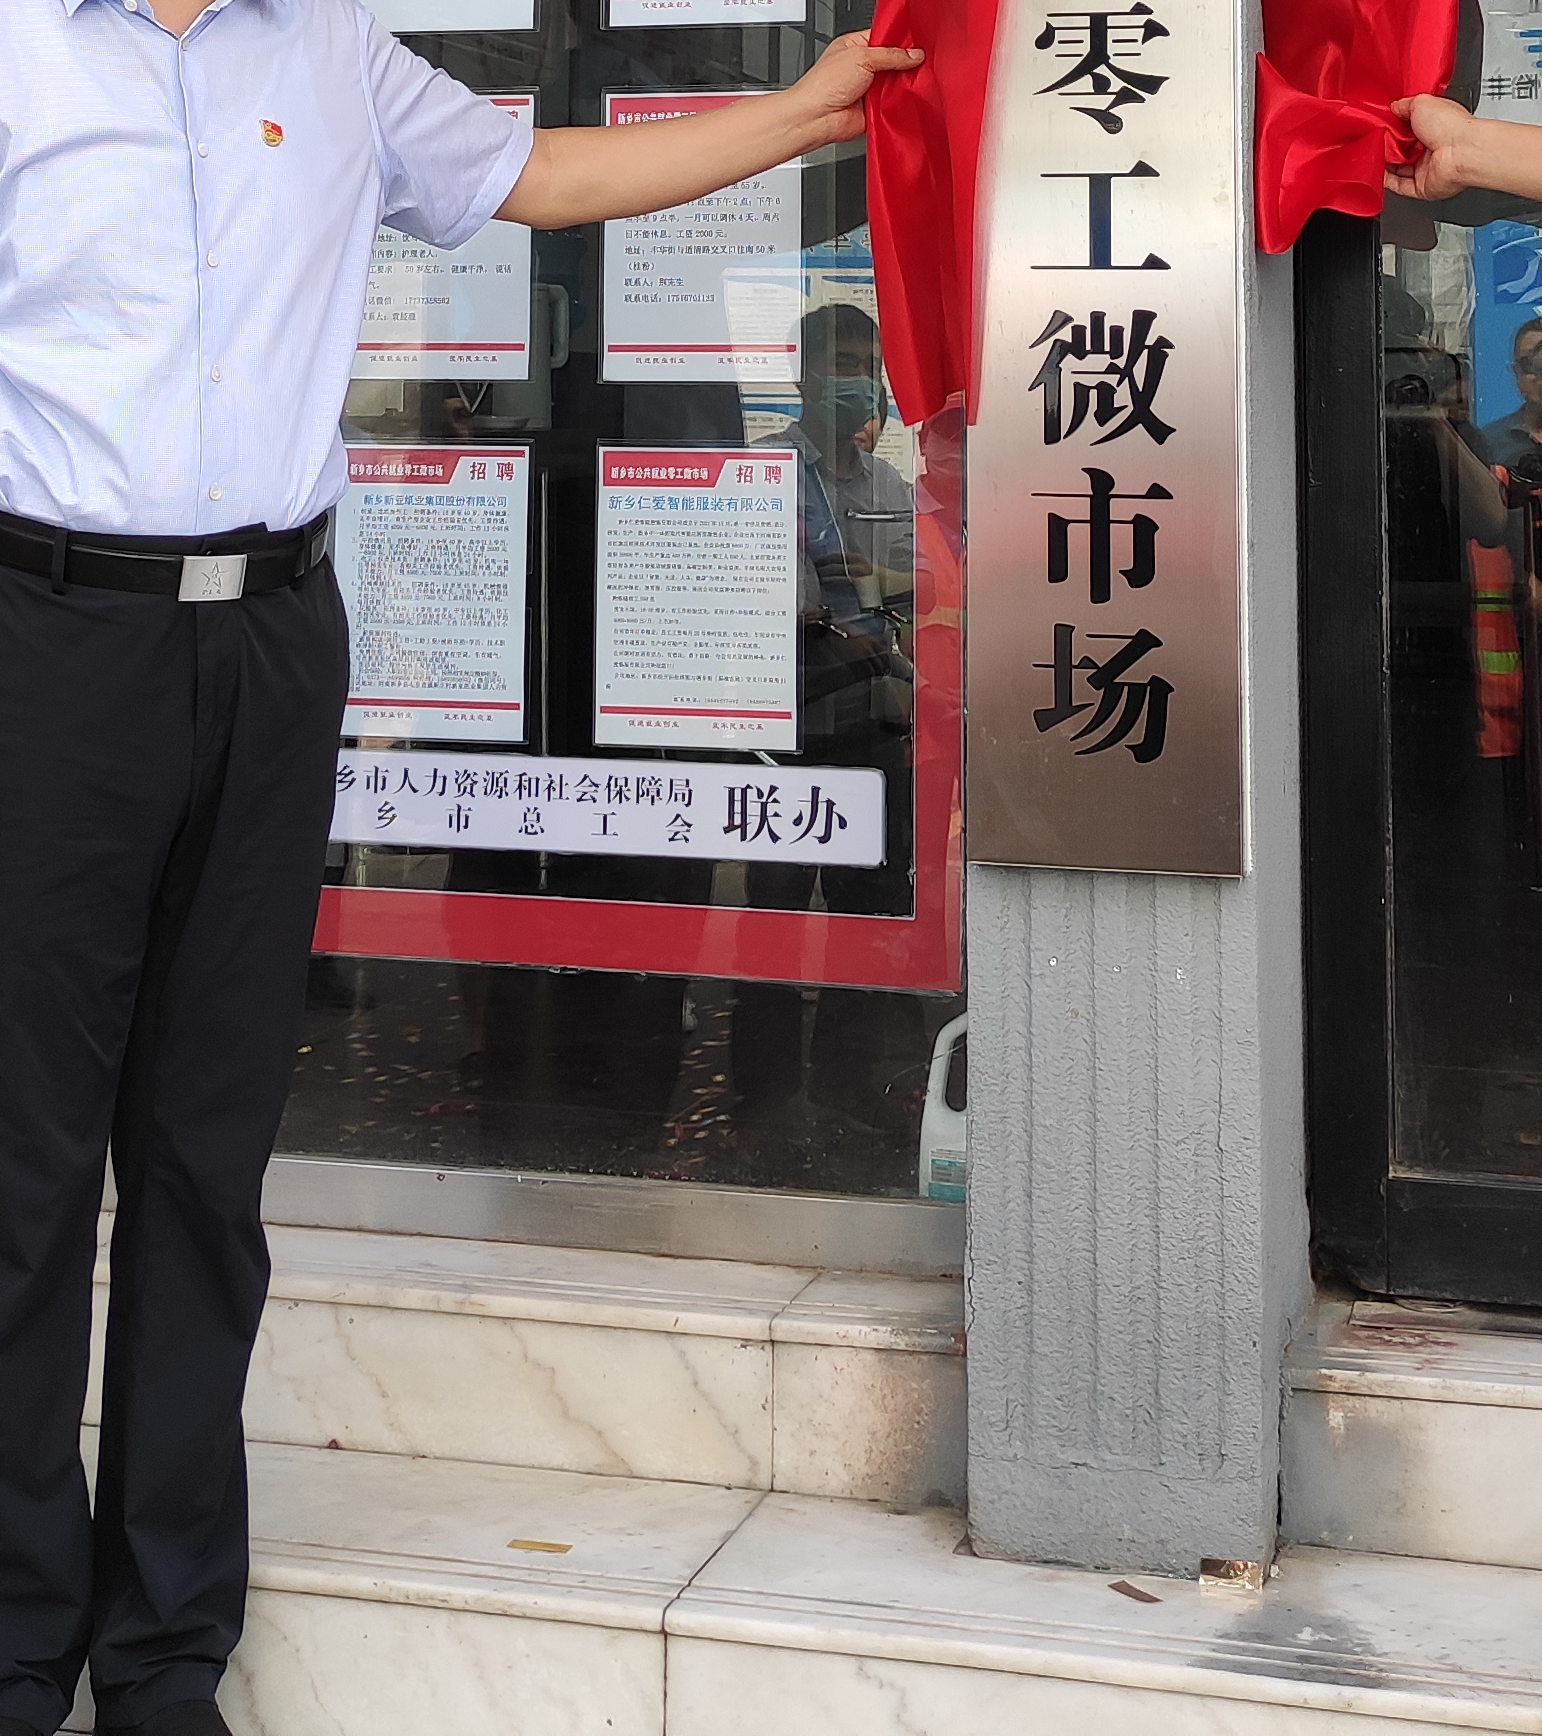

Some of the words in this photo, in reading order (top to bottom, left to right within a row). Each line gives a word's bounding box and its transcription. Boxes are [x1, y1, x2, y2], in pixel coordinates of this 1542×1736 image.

[470, 461, 515, 481] 招聘
[736, 465, 783, 485] 招聘
[608, 496, 784, 511] 新乡仁爱智能服装有限公司
[723, 782, 849, 845] 联办
